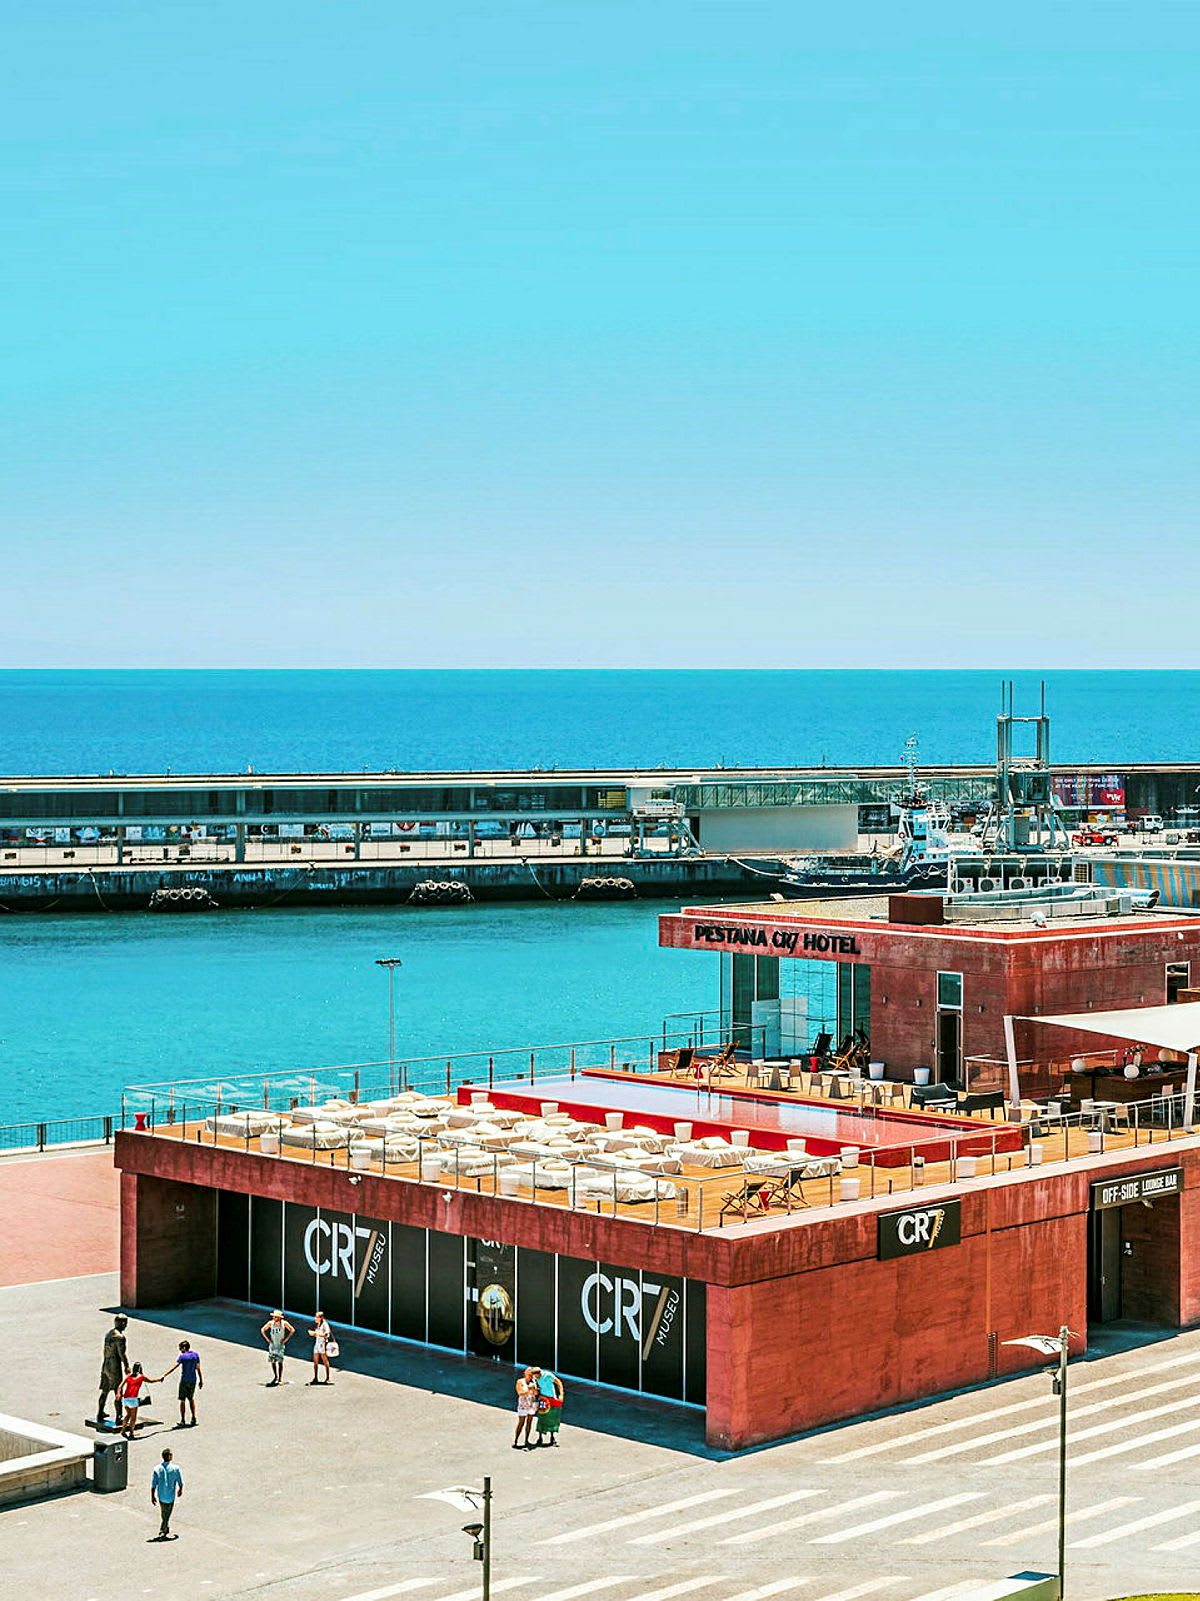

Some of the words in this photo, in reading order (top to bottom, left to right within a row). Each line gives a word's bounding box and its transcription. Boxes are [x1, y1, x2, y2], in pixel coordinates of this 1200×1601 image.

[695, 925, 767, 947] PESTANA
[772, 931, 799, 954] CR7
[803, 933, 861, 955] HOTEL
[1103, 1182, 1139, 1204] OFF-SIDE
[1142, 1177, 1164, 1191] LOUNGE
[1165, 1174, 1177, 1187] BAR
[897, 1209, 943, 1248] CR7
[304, 1218, 378, 1298] CR7
[366, 1233, 386, 1284] MUSEU
[581, 1273, 670, 1361] CR7
[656, 1290, 680, 1346] MUSEU
